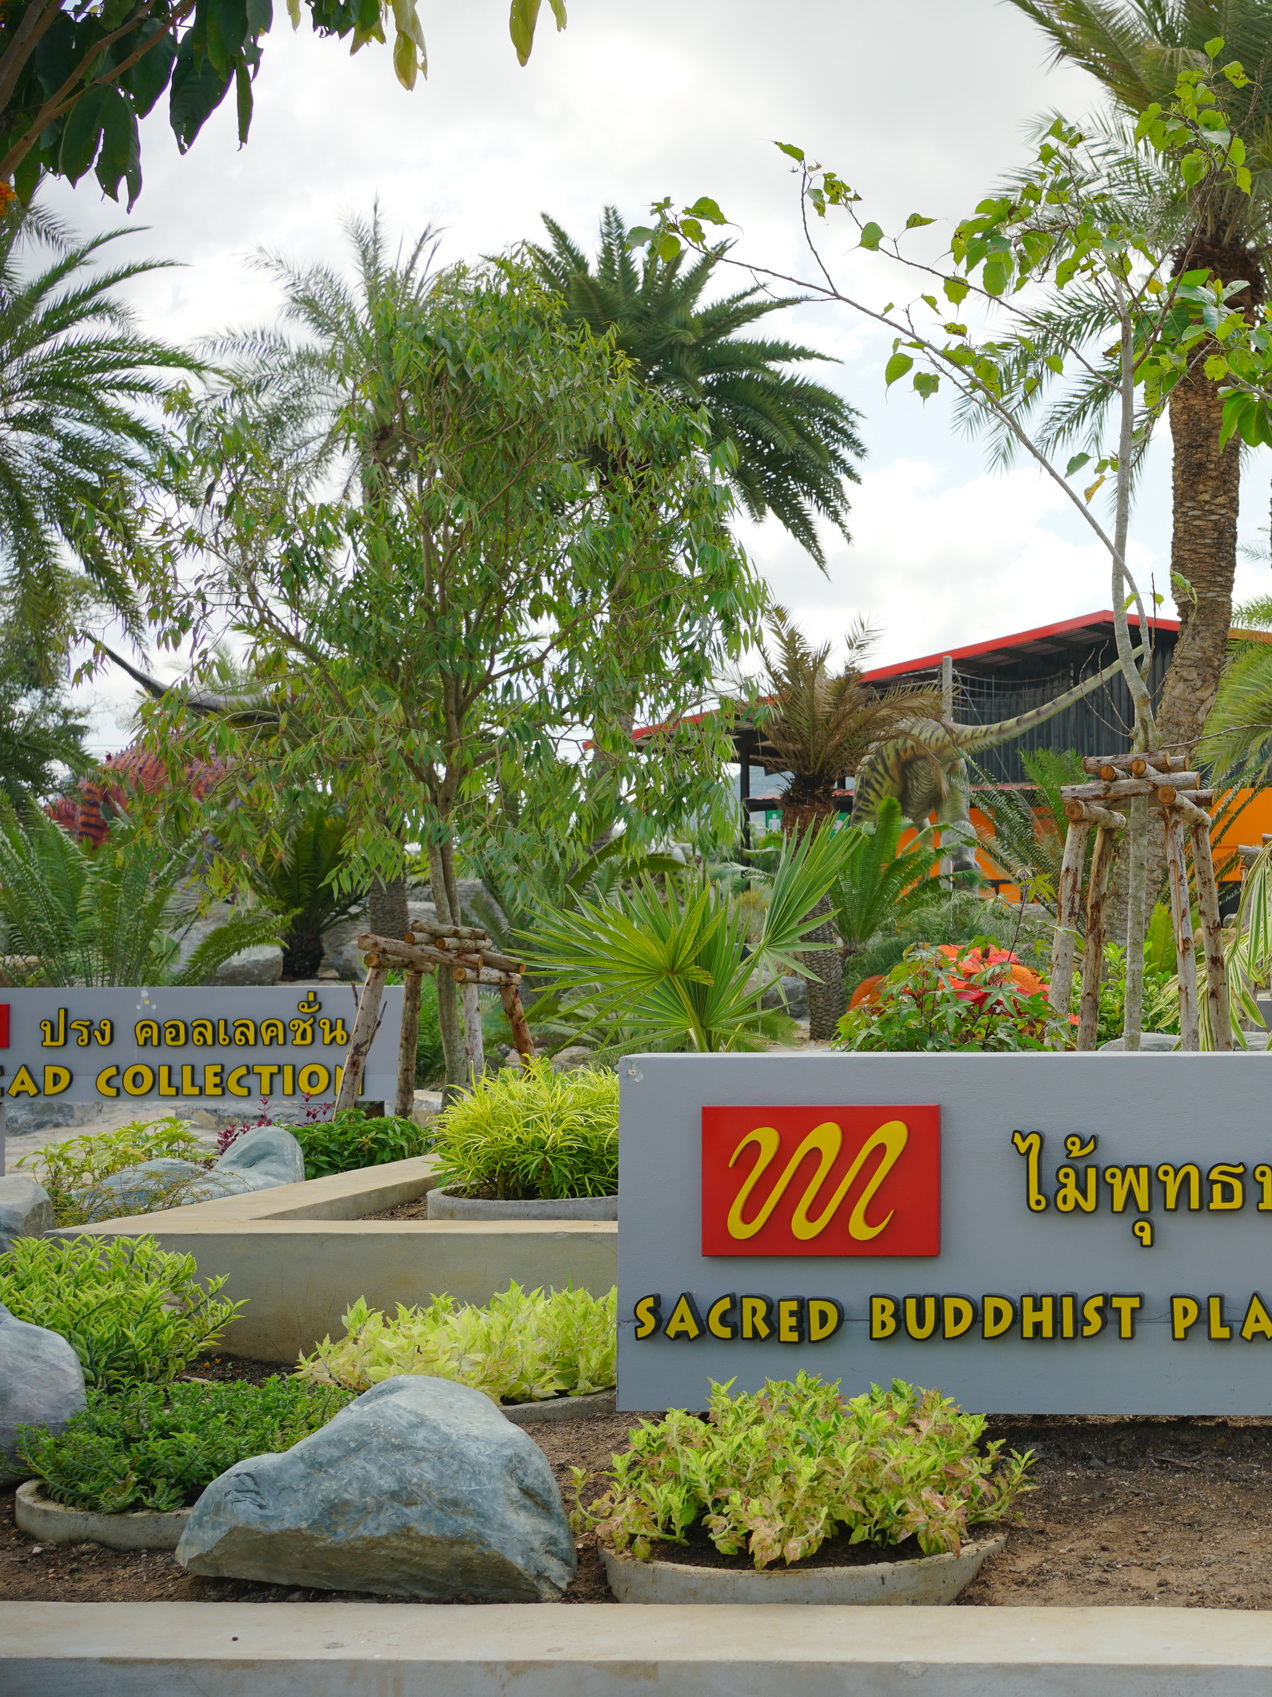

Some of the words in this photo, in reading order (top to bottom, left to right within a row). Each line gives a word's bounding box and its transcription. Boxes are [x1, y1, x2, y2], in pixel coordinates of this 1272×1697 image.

[40, 1007, 113, 1049] ปรง
[135, 990, 350, 1047] คอลเลคชั่น
[0, 1064, 73, 1098] AD
[634, 1292, 843, 1344] SACRED
[870, 1292, 1142, 1342] BUDDHIST
